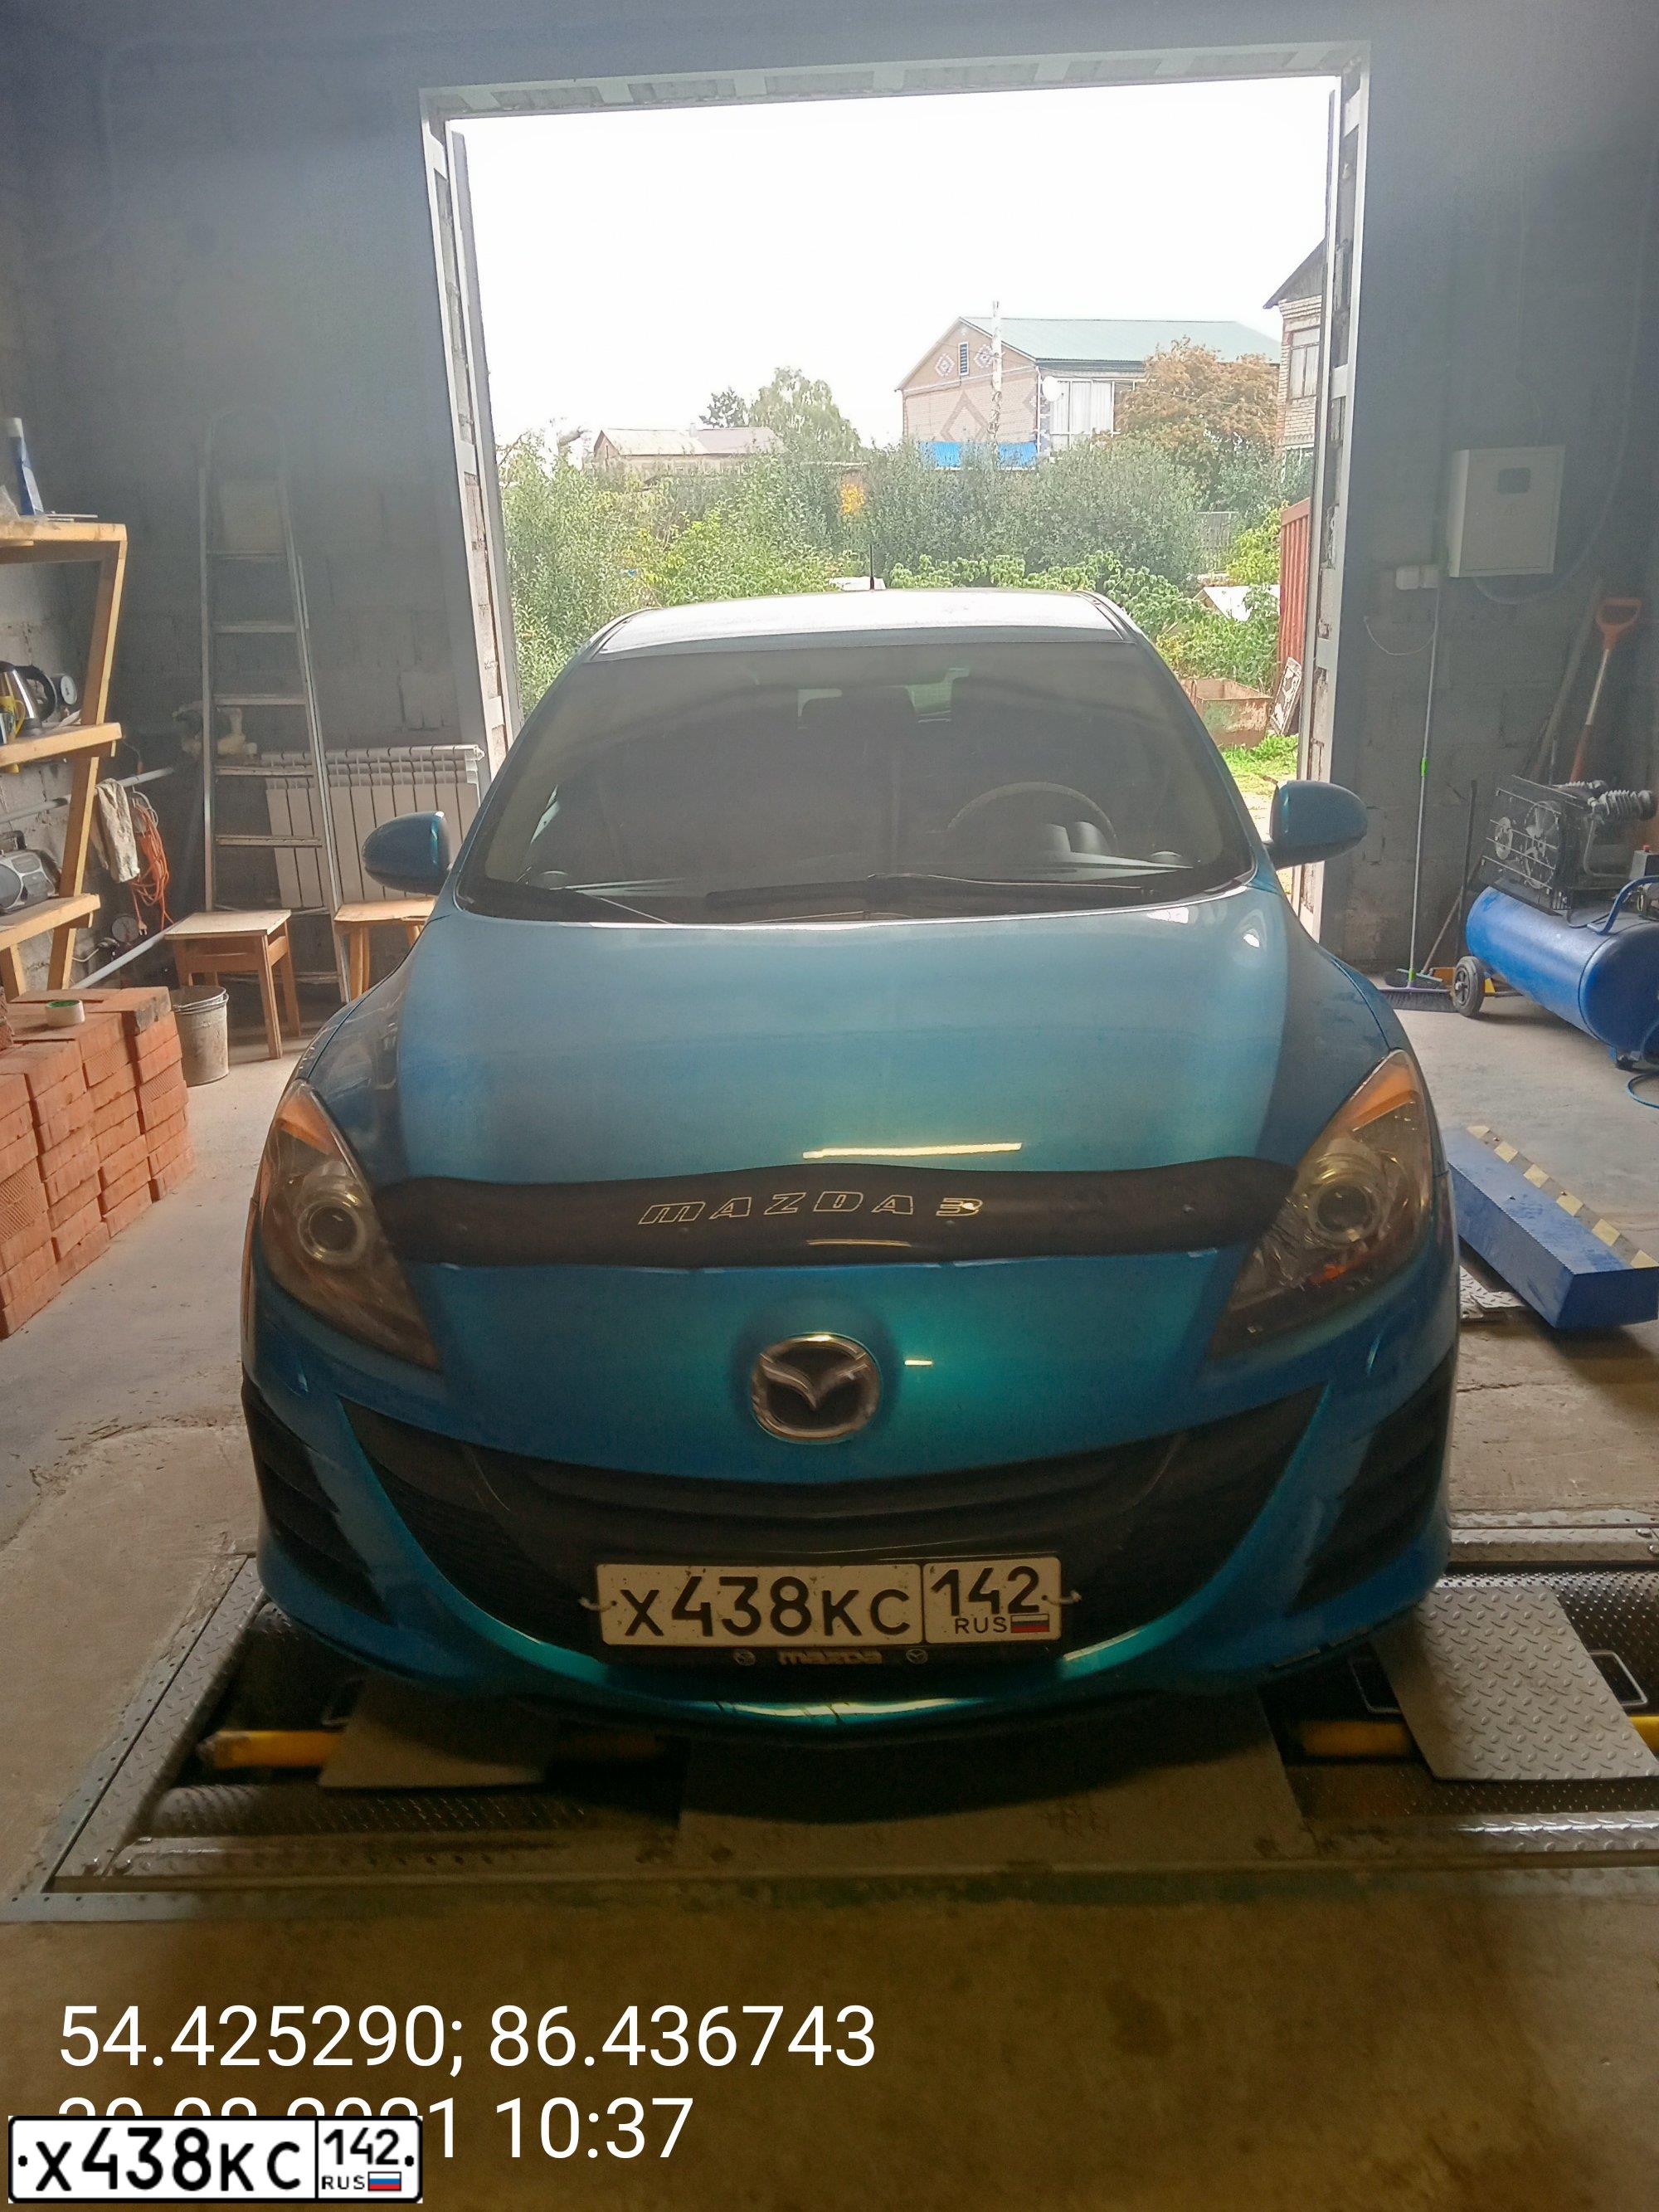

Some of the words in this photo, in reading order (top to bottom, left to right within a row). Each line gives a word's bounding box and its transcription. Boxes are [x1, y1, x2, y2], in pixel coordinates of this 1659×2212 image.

[638, 1191, 913, 1225] MAZDA
[936, 1197, 985, 1217] 3
[932, 1566, 1039, 1616] 142
[955, 1616, 1008, 1635] RUS
